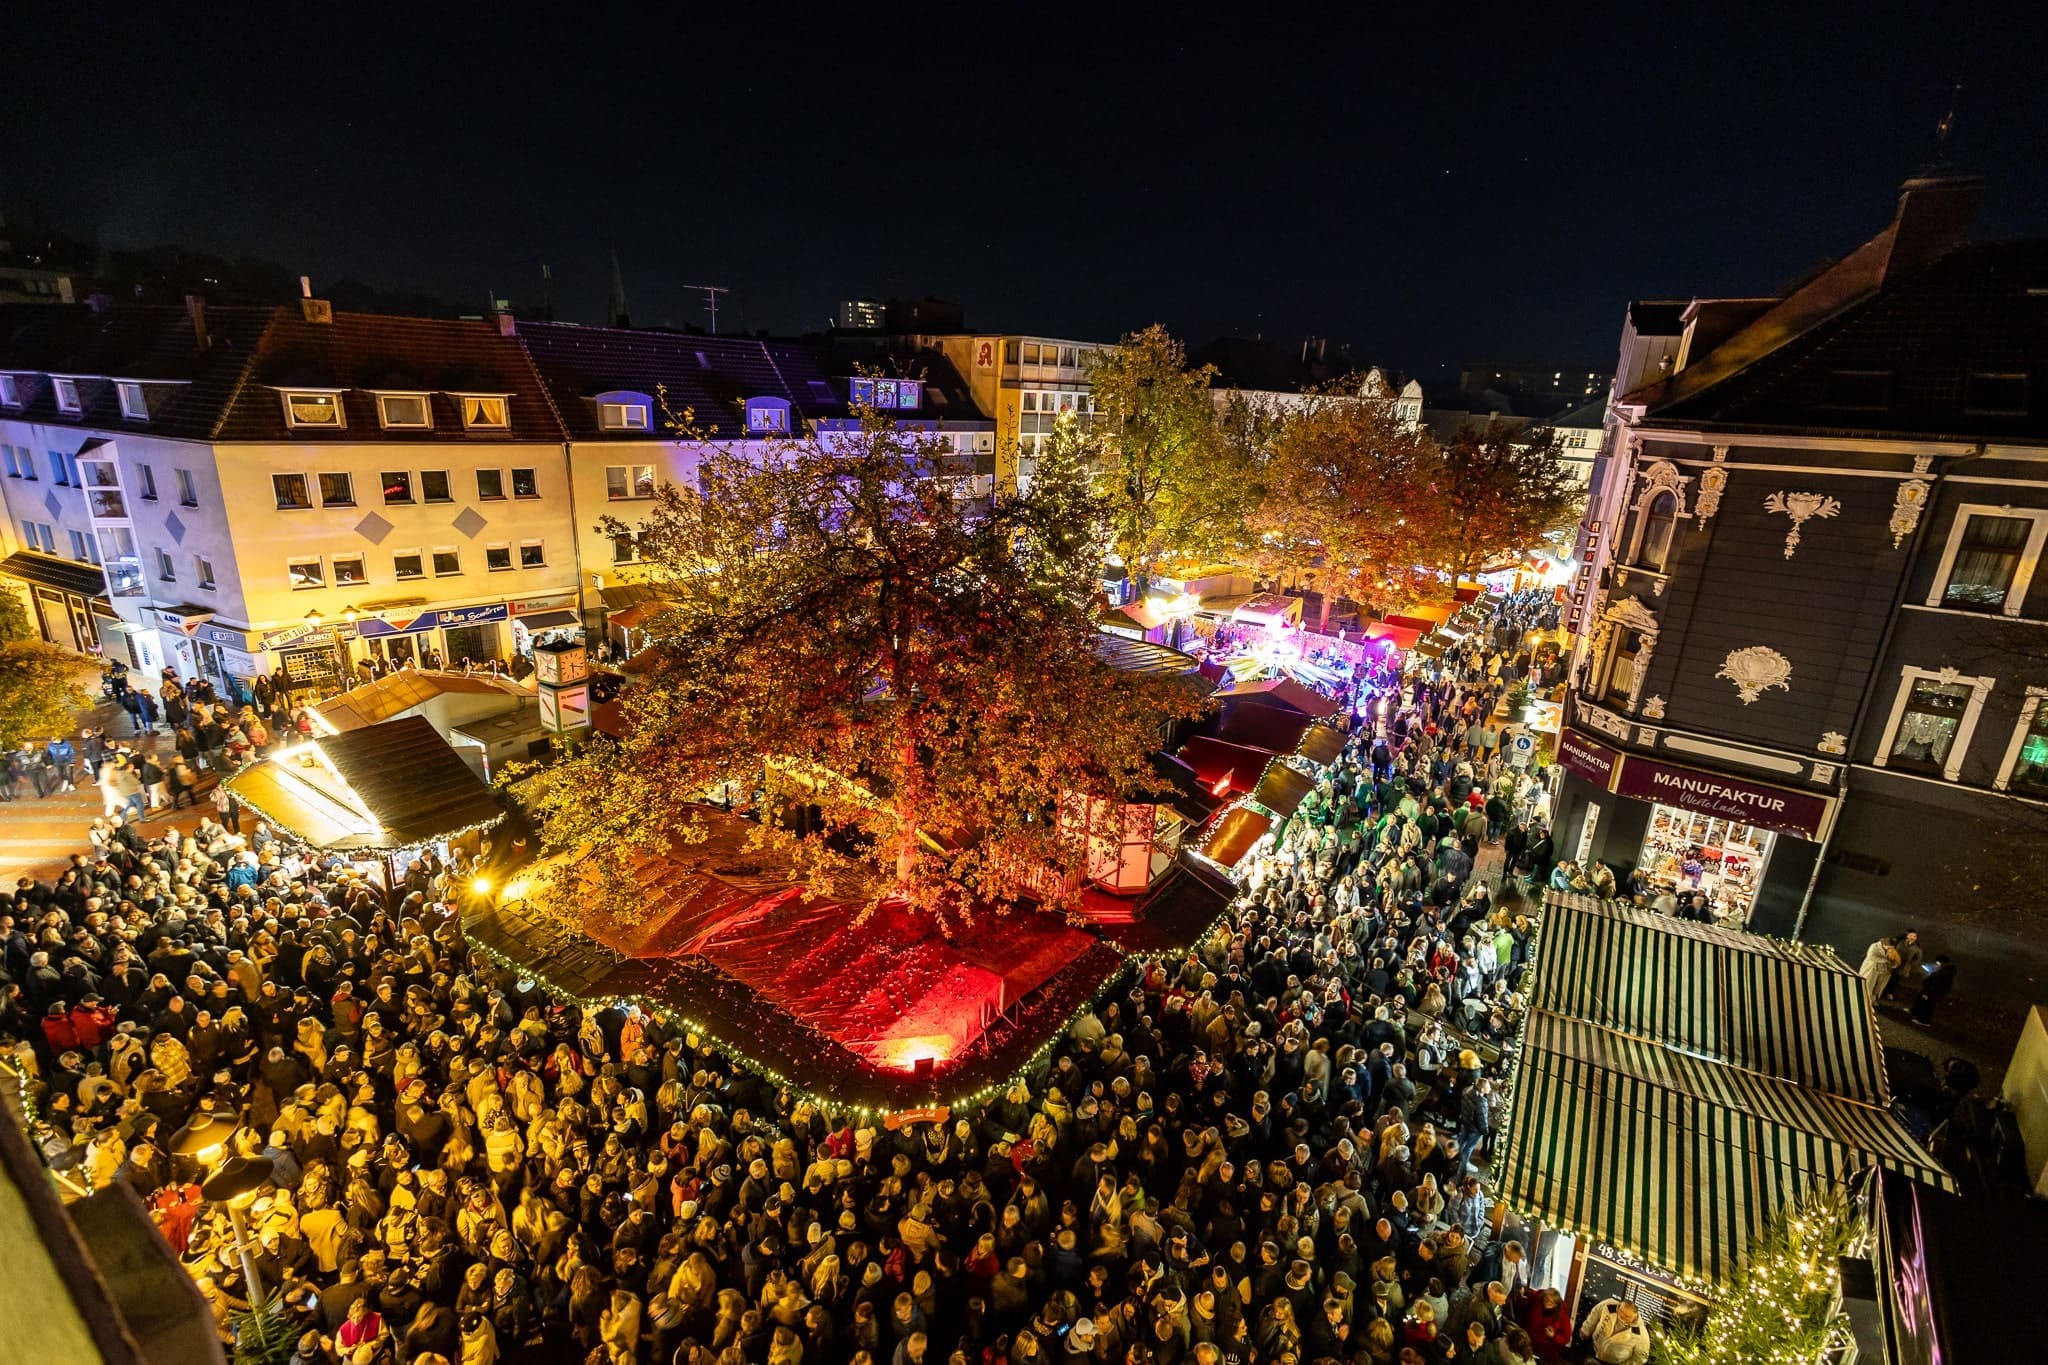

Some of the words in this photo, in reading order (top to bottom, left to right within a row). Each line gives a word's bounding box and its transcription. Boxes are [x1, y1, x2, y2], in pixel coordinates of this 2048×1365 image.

[1562, 741, 1610, 771] MANUFAKTUR
[1654, 772, 1785, 812] MANUFAKTUR
[1680, 791, 1711, 808] Werte
[1712, 800, 1747, 817] Laden
[1653, 842, 1751, 874] MANUFAKTUR
